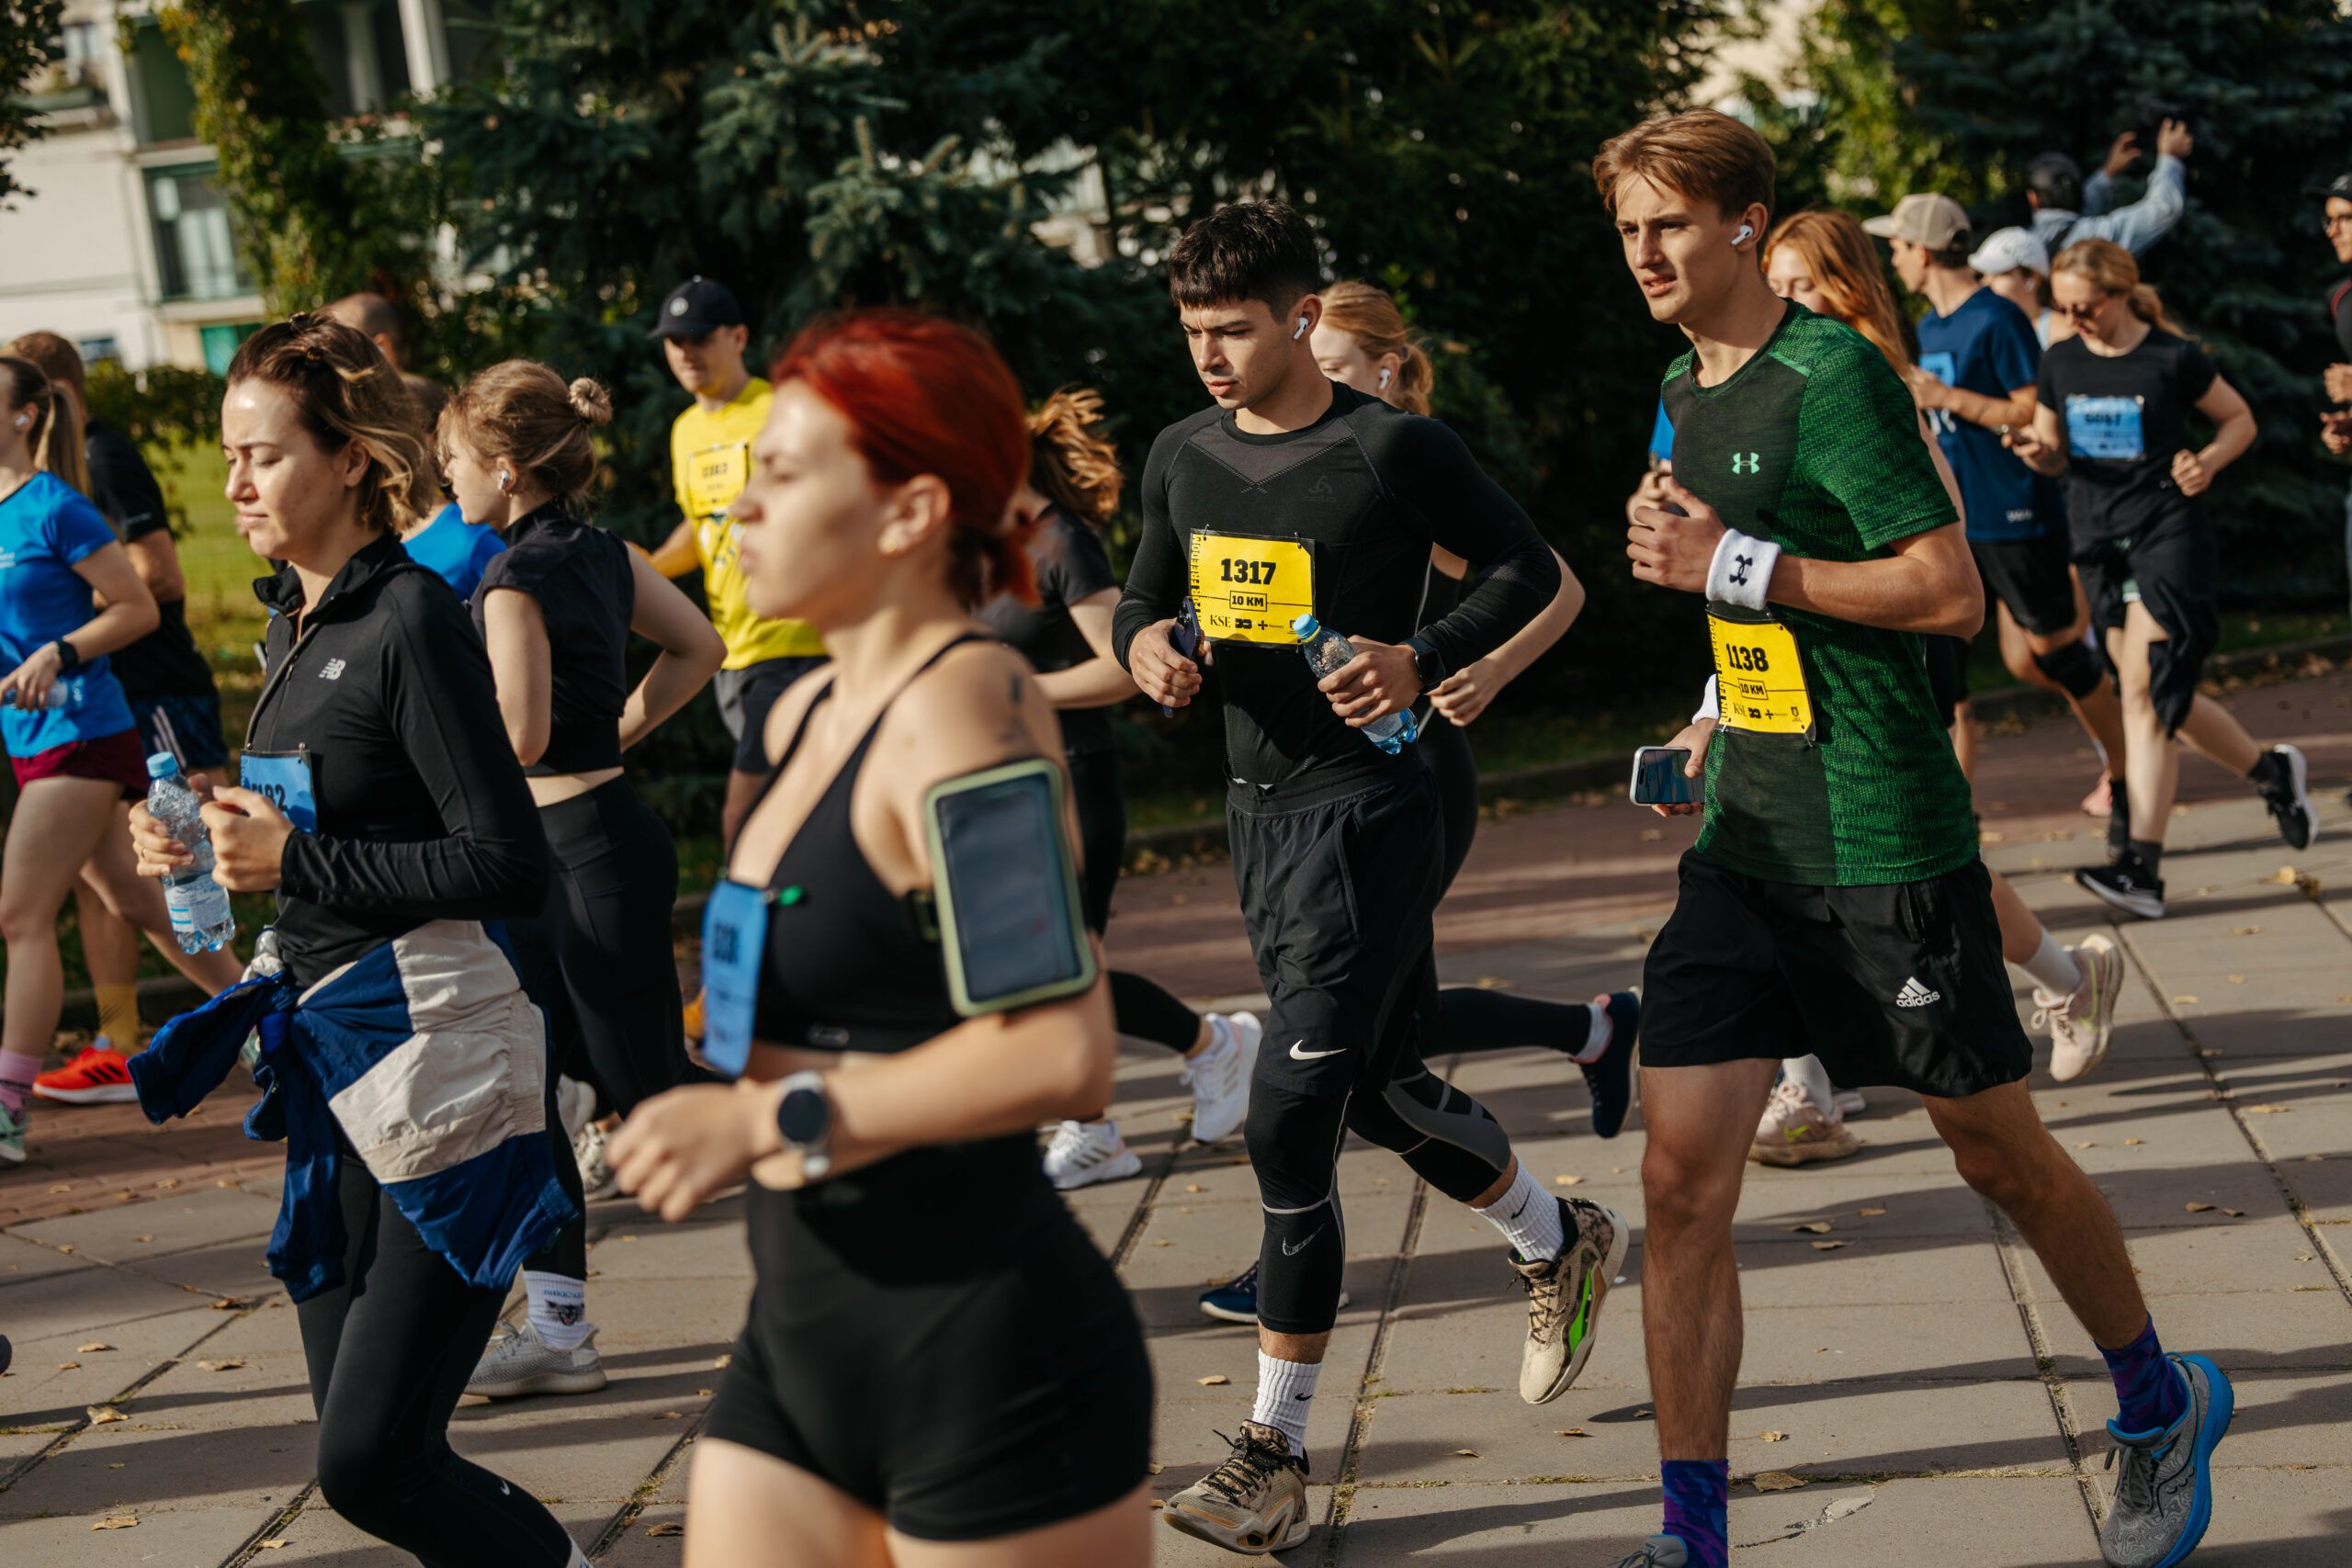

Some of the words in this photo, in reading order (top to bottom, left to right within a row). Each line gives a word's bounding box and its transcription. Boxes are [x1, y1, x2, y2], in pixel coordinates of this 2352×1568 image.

[1190, 535, 1201, 585] FREEDOM
[1220, 558, 1276, 585] 1317
[1231, 595, 1244, 605] 10
[1246, 596, 1264, 607] KM
[1210, 615, 1231, 628] KSE
[1725, 643, 1769, 671] 1138
[1740, 682, 1748, 694] 10
[1750, 683, 1764, 695] KM
[1895, 990, 1940, 1008] adidas
